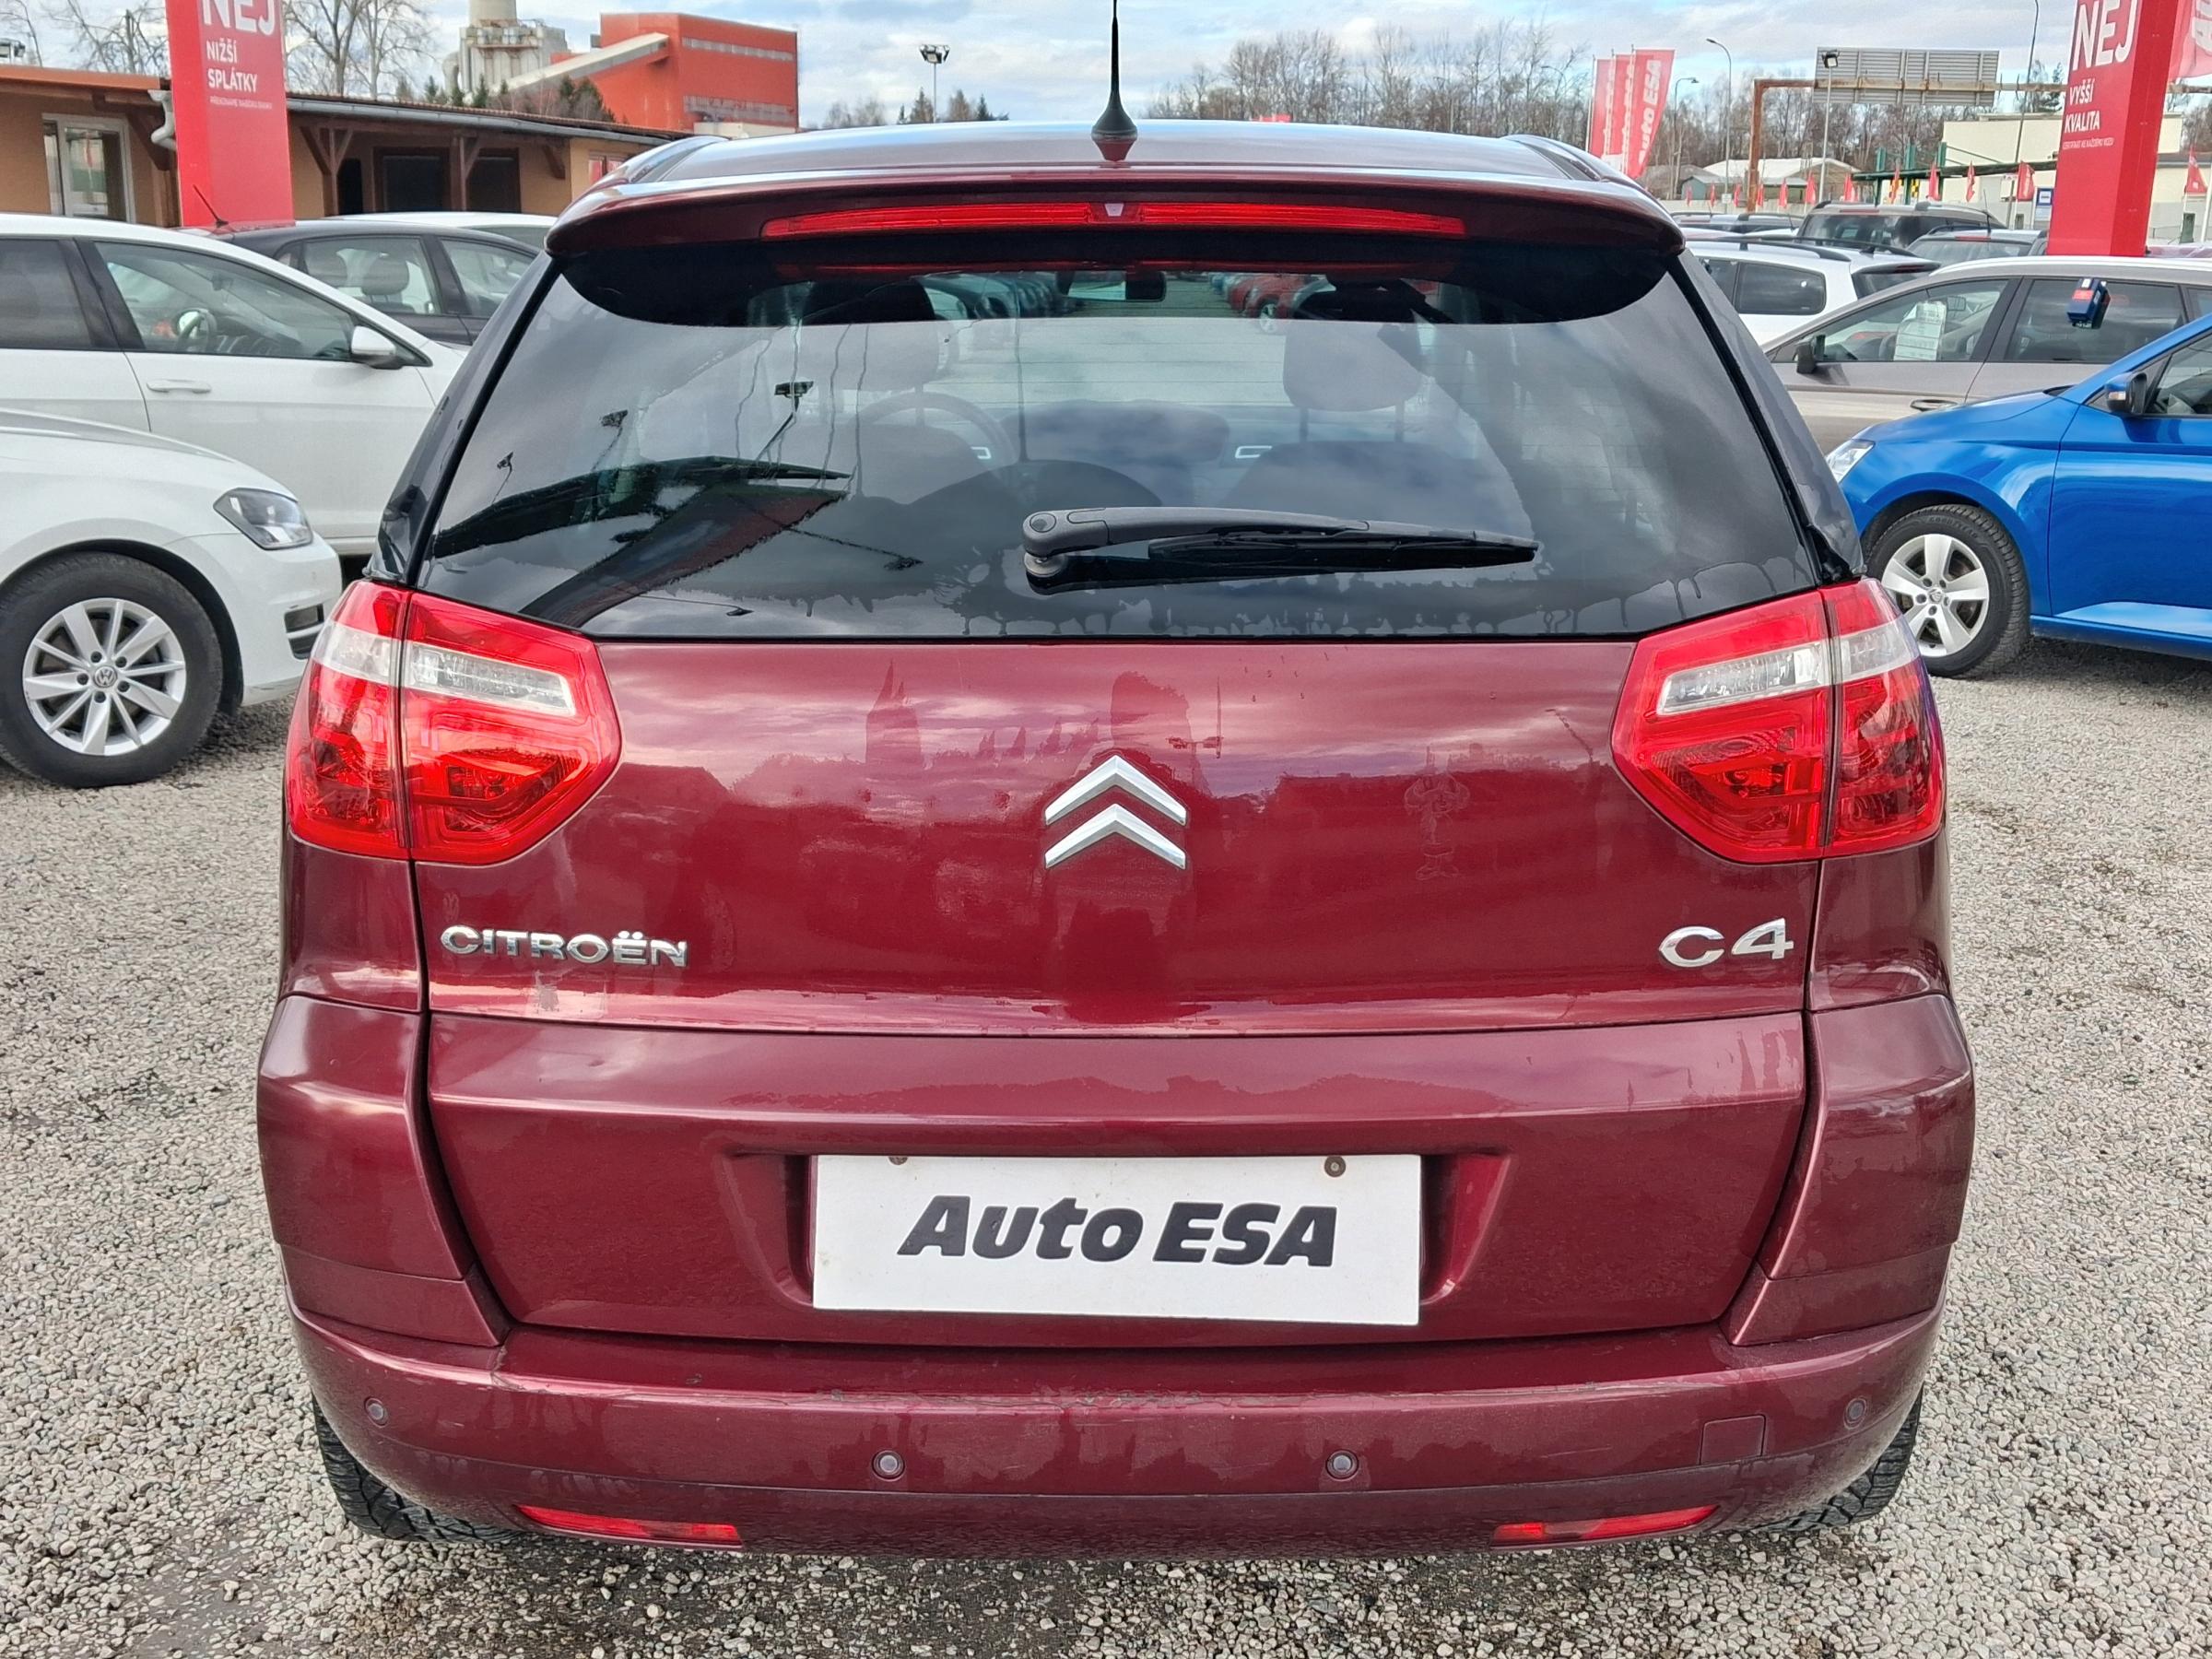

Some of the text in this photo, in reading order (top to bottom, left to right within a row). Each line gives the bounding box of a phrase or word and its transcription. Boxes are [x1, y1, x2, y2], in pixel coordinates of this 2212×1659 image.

[206, 37, 238, 64] NIŽŠÍ
[2072, 0, 2138, 71] NEJ
[207, 66, 258, 93] SPLÁTKY
[2069, 77, 2095, 106] VYŠŠÍ
[2065, 110, 2100, 134] KVALITA
[441, 924, 687, 967] CITROËN
[1658, 917, 1794, 968] C4
[897, 1194, 1337, 1267] Auto ESA
